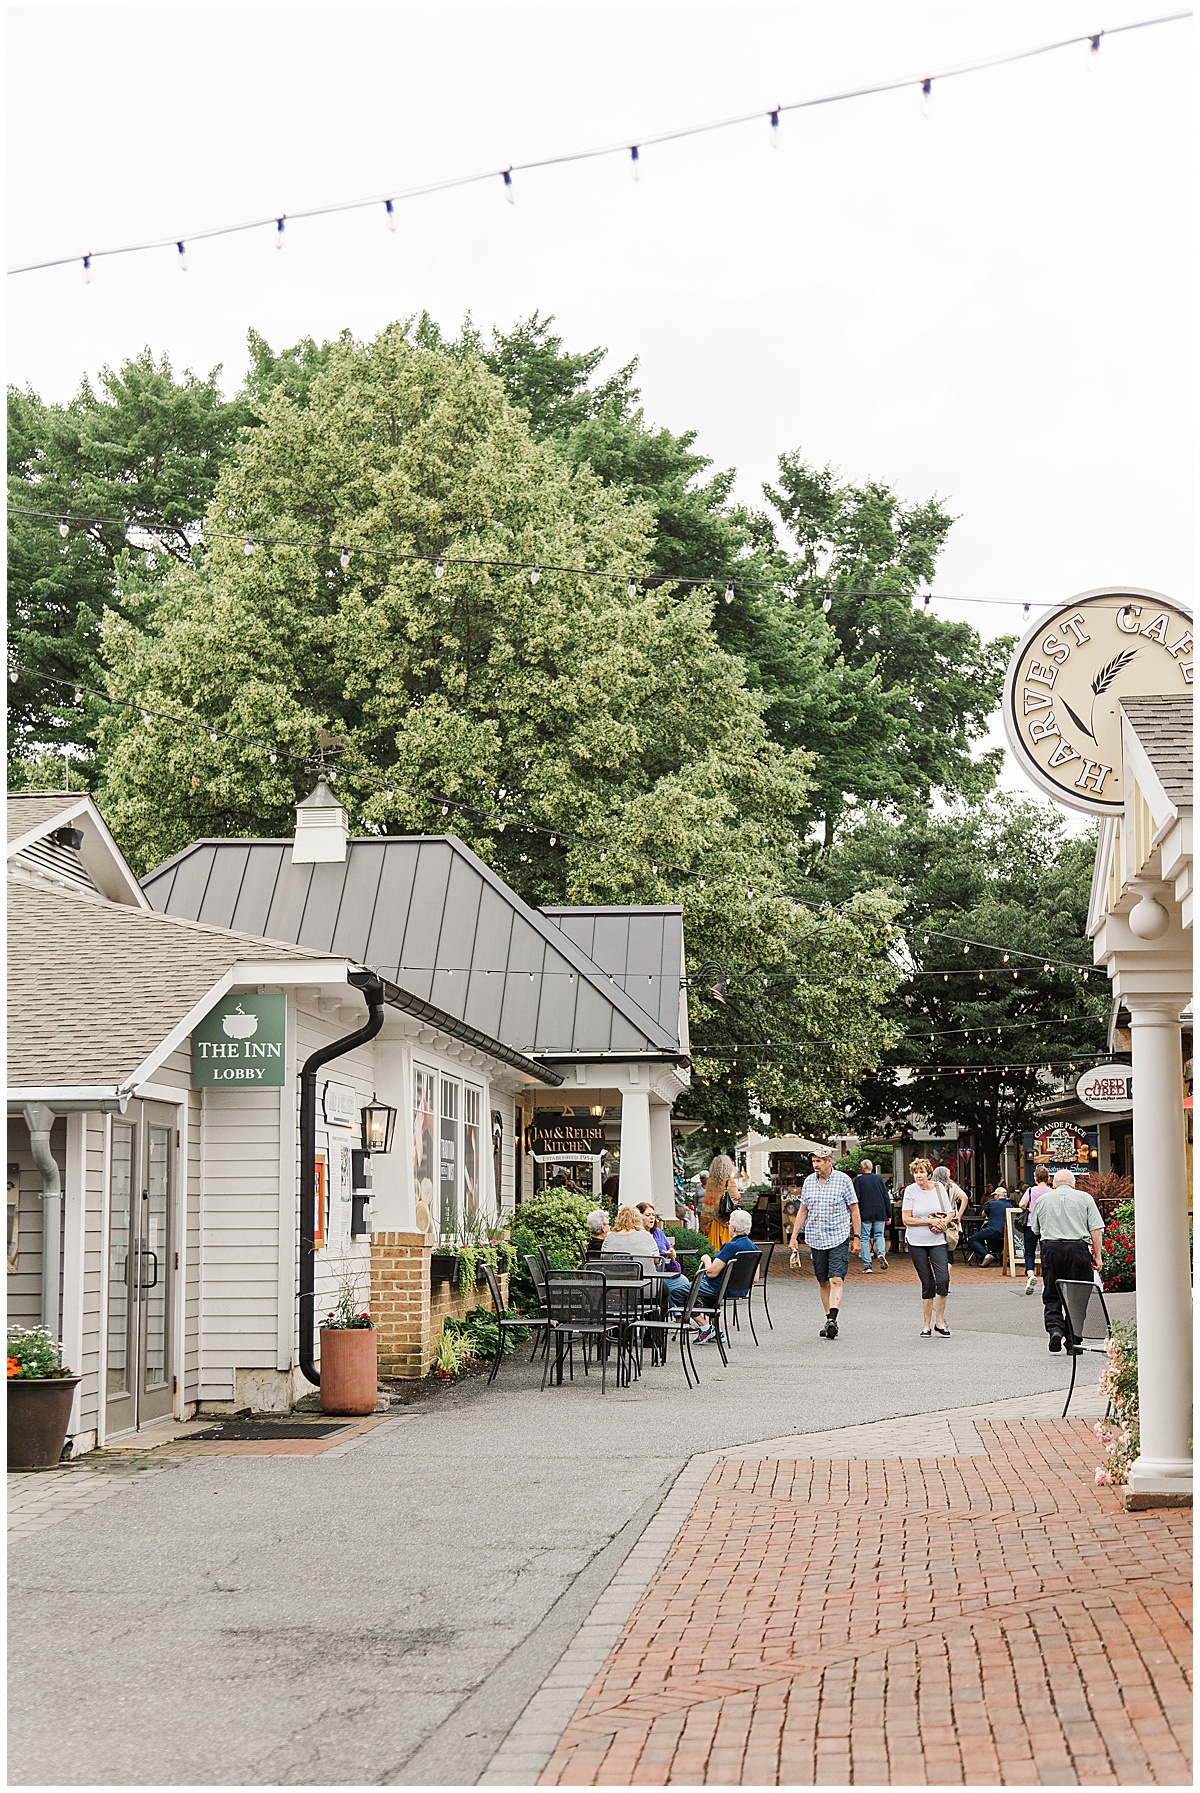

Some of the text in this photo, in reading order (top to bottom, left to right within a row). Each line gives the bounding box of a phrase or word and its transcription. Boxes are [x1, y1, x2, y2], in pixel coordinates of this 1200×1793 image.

[1024, 613, 1112, 794] HARVEST
[198, 1041, 282, 1058] THE INN
[213, 1068, 266, 1079] LOBBY
[1093, 1078, 1125, 1088] AGED
[1084, 1086, 1126, 1096] CURED
[565, 1126, 603, 1139] RELISH
[1034, 1121, 1087, 1138] GRANDE PLACE
[543, 1139, 592, 1152] KITCHEN
[579, 1154, 594, 1162] 1954
[1070, 1163, 1088, 1173] Shop
